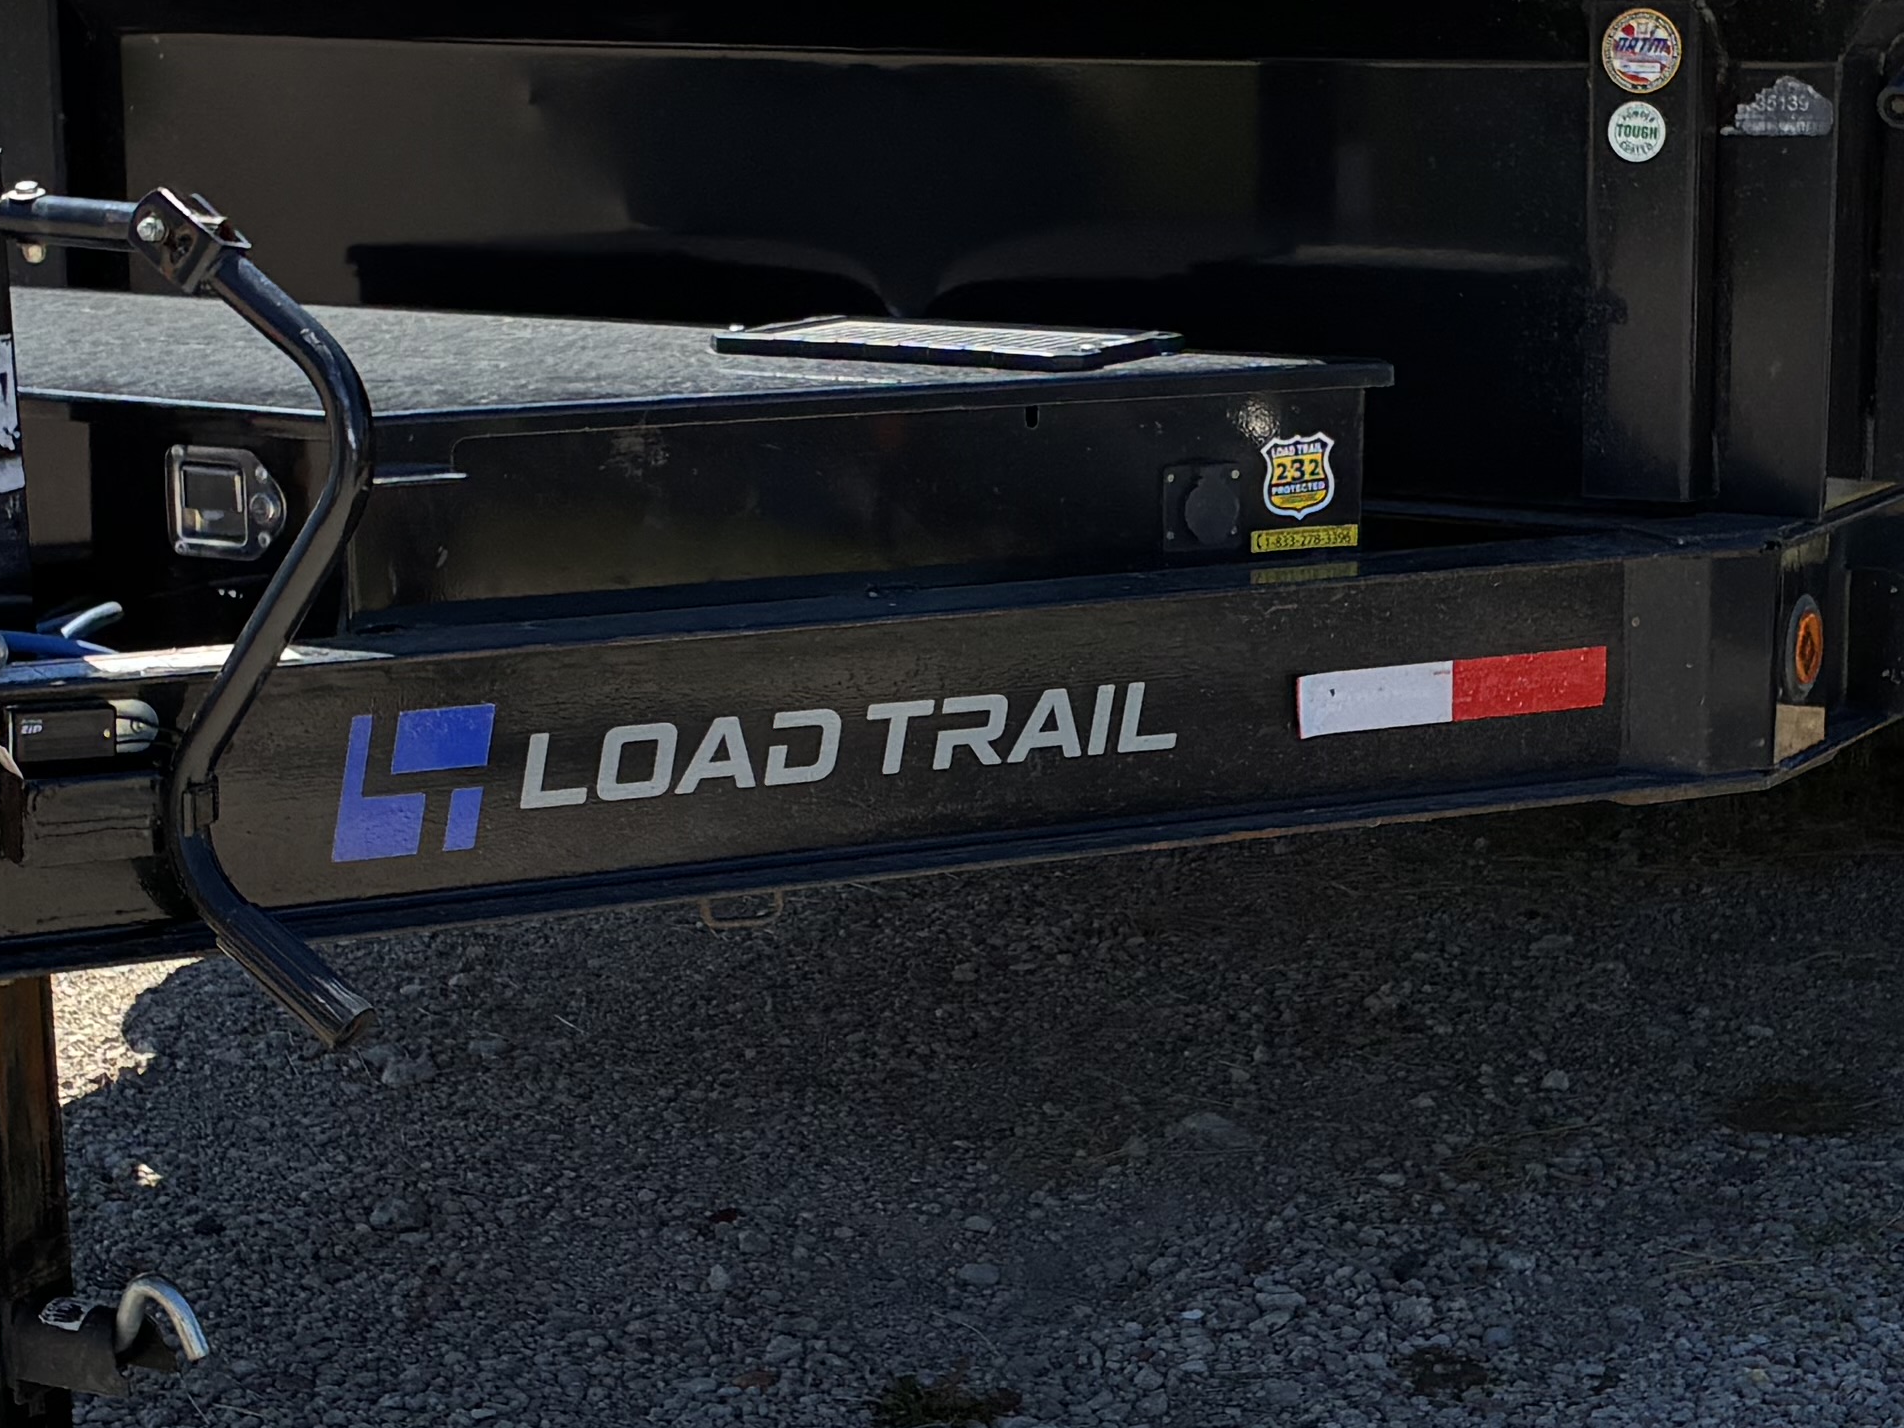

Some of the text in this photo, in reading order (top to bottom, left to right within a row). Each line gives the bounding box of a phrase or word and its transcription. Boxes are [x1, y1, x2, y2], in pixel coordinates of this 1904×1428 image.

[1616, 123, 1658, 140] TOUGH
[1271, 445, 1296, 459] LOAD
[1276, 458, 1321, 482] 232
[1271, 480, 1326, 496] PROTECTED
[519, 681, 1178, 810] LOAD TRAIL
